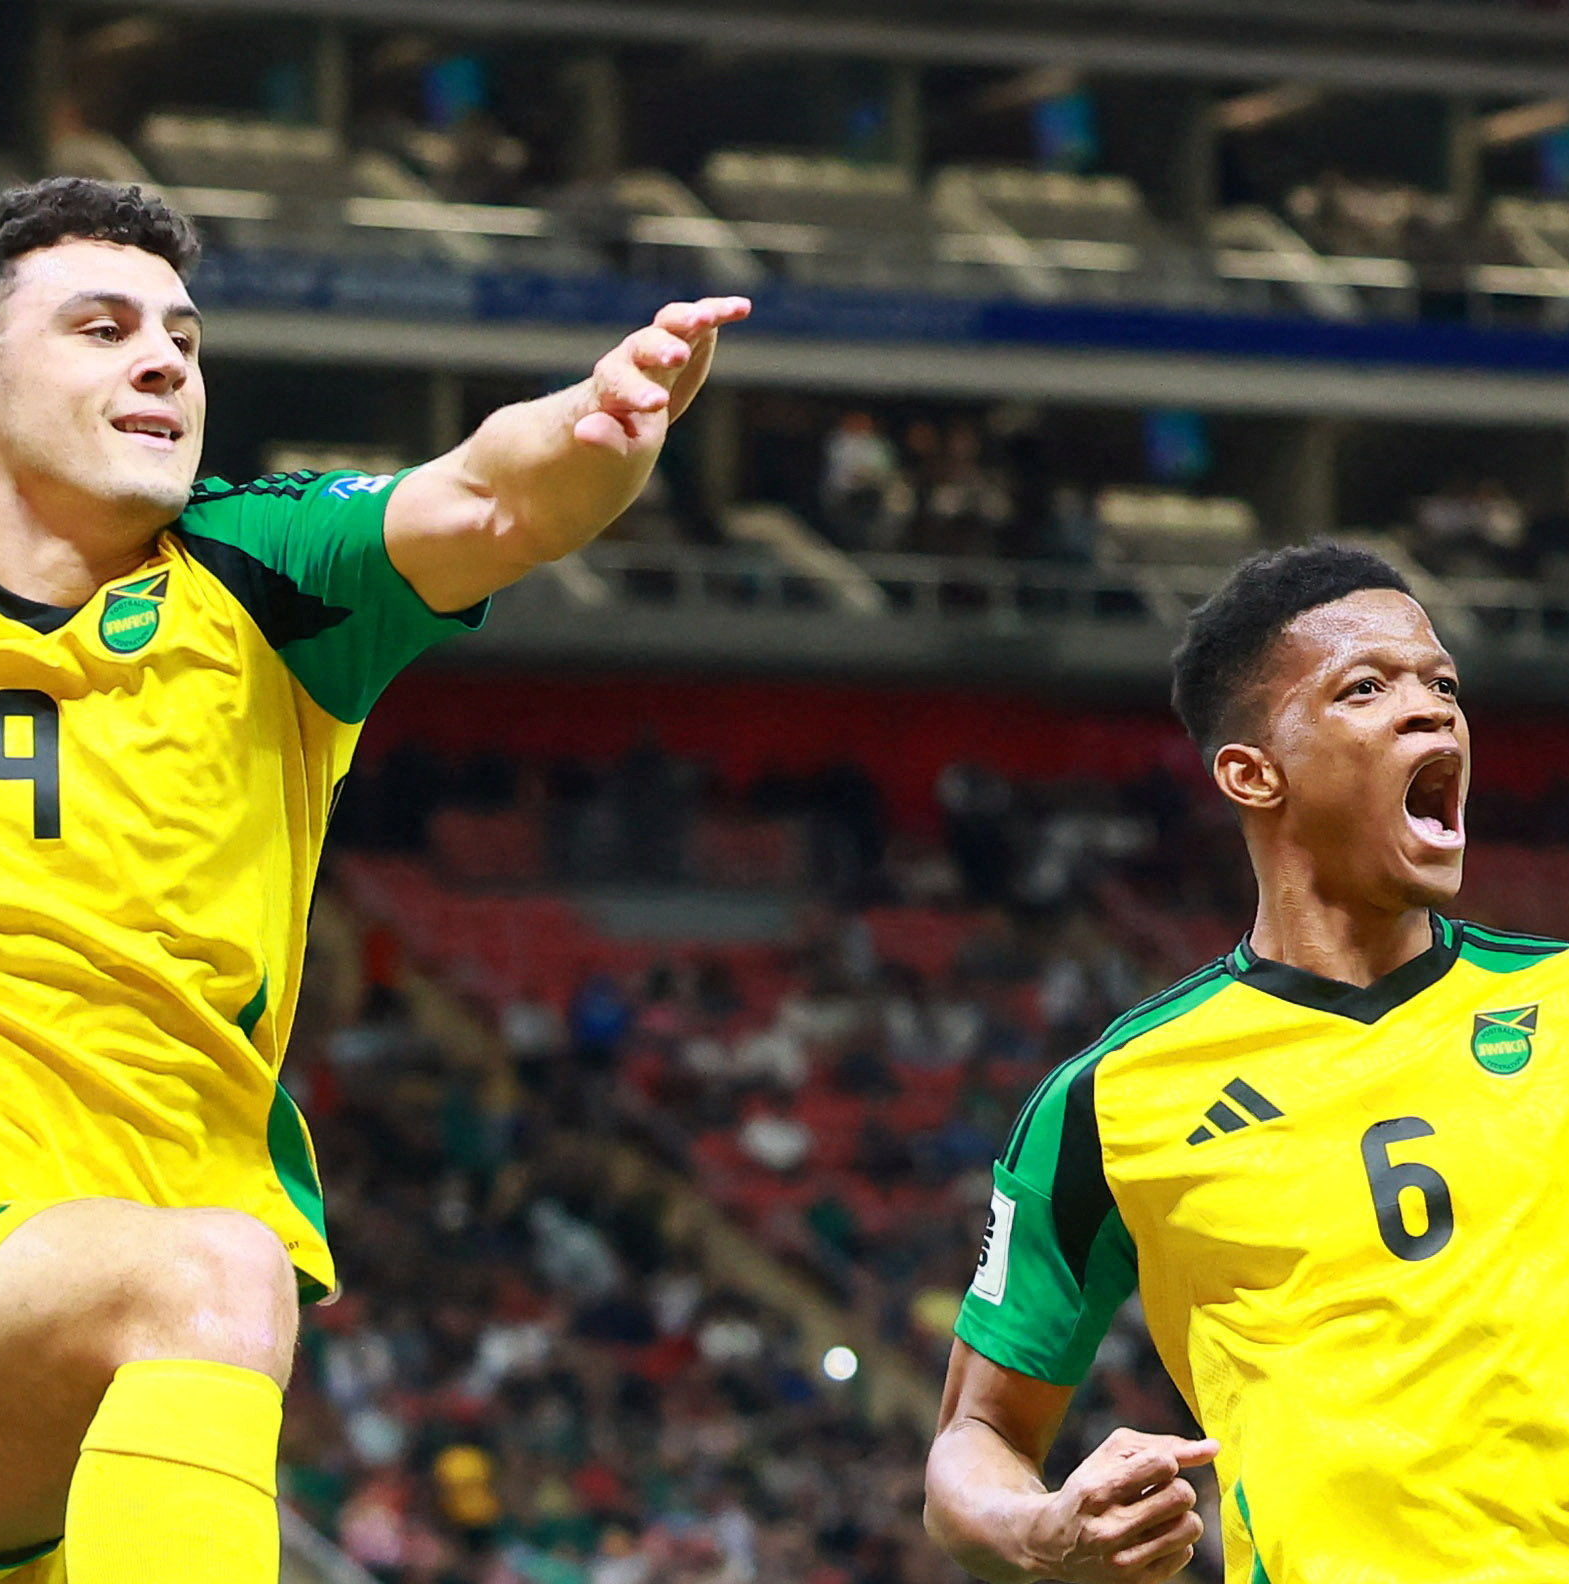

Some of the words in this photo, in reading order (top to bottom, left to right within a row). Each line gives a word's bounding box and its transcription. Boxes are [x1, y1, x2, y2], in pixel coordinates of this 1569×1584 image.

[109, 600, 146, 616] FOOTBALL
[103, 611, 156, 636] JAMAICA
[1477, 1039, 1527, 1056] JAMAICA
[1360, 1116, 1454, 1261] 6
